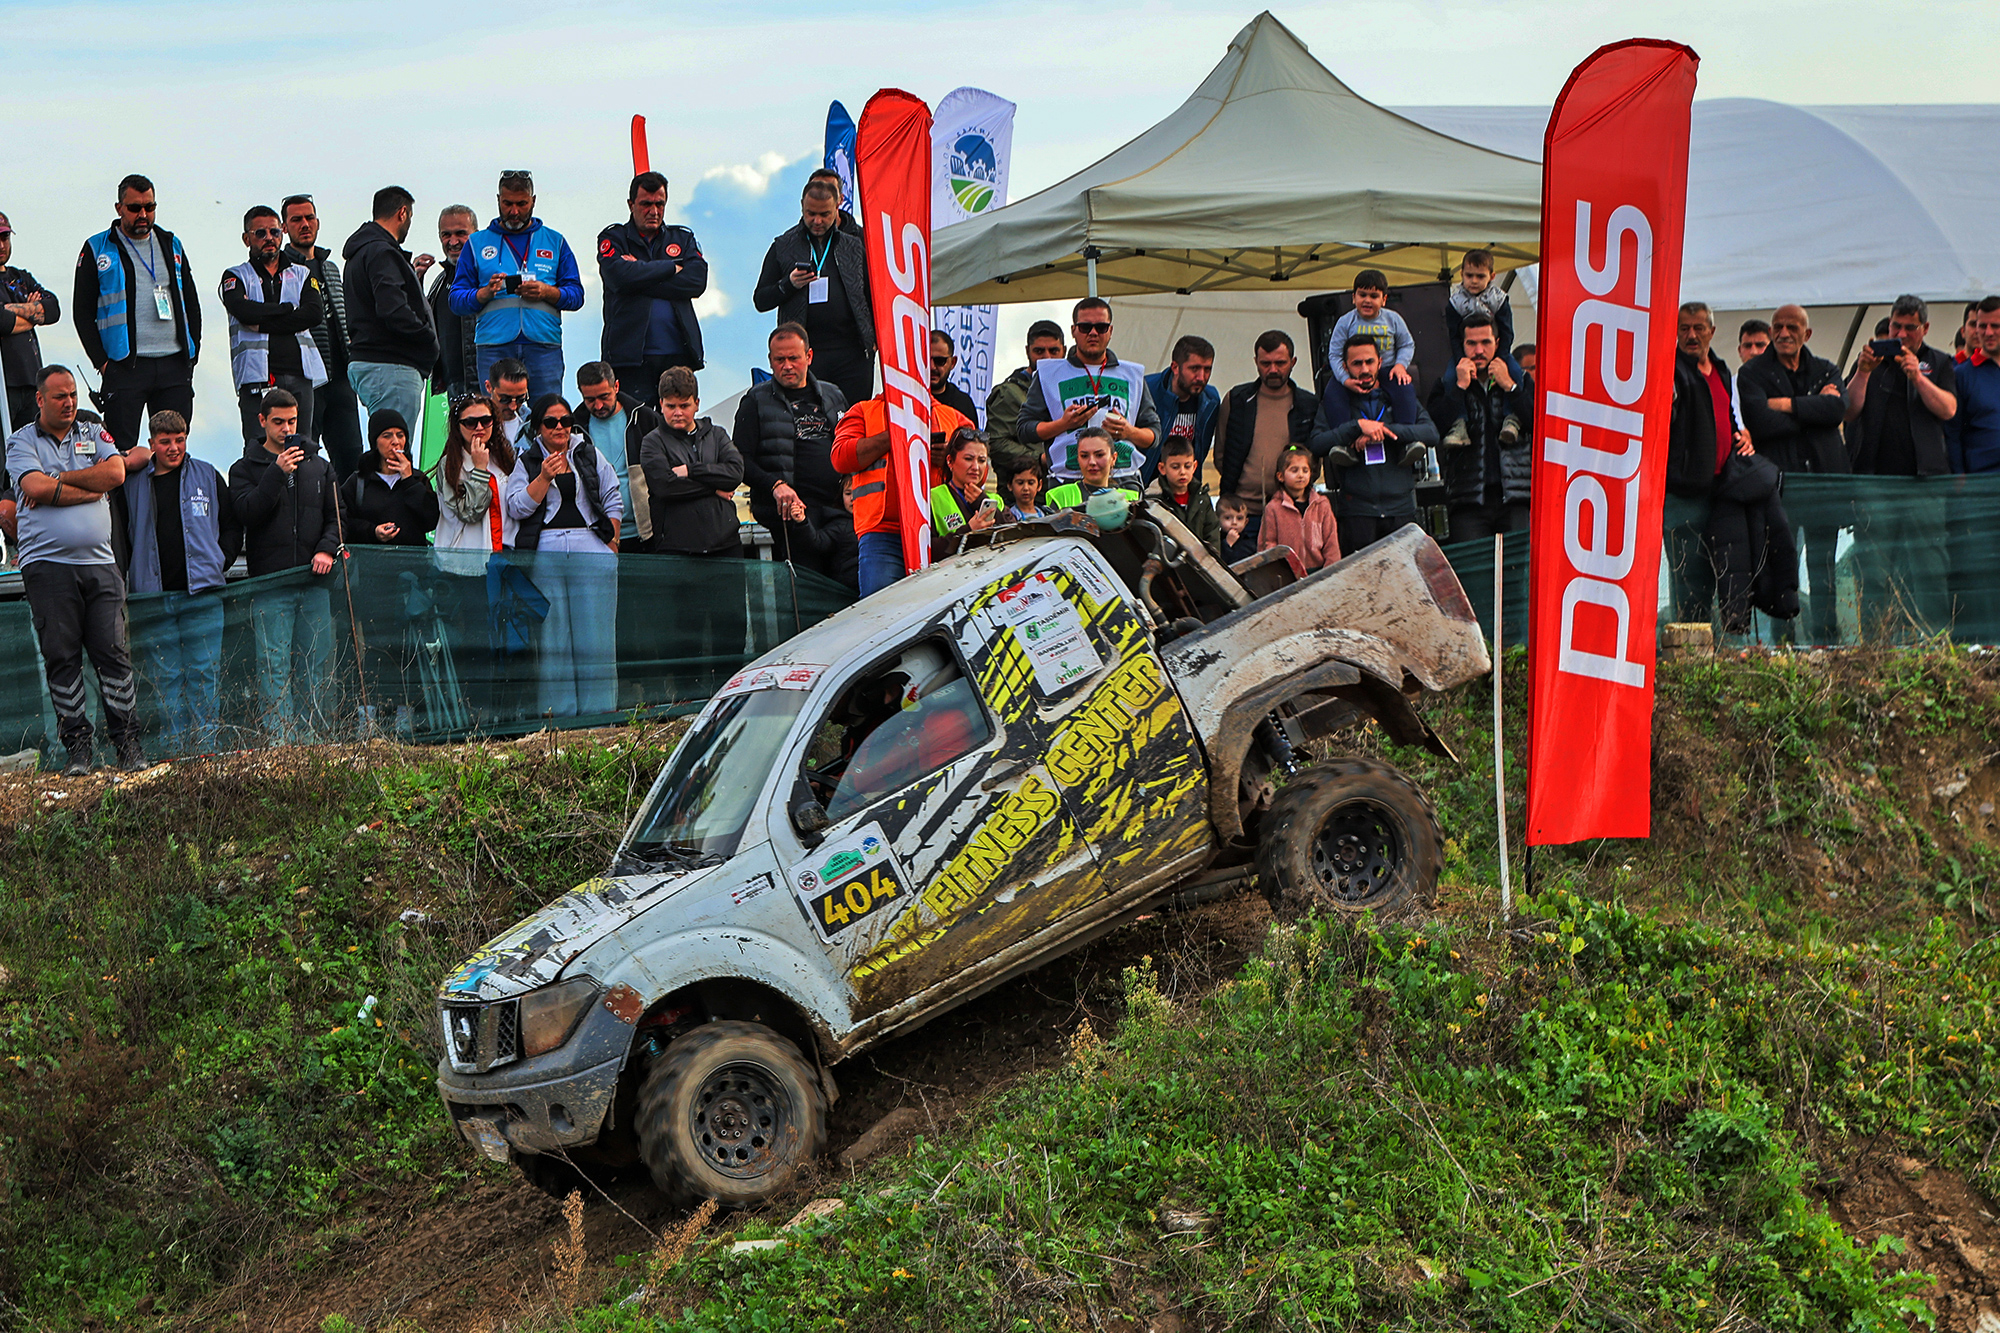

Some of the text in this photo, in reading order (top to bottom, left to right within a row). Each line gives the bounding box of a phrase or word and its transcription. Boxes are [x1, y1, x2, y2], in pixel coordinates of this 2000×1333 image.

[1544, 199, 1653, 689] petlas
[824, 869, 897, 925] 404
[921, 774, 1061, 922] FITNESS
[1045, 652, 1166, 788] CENTER
